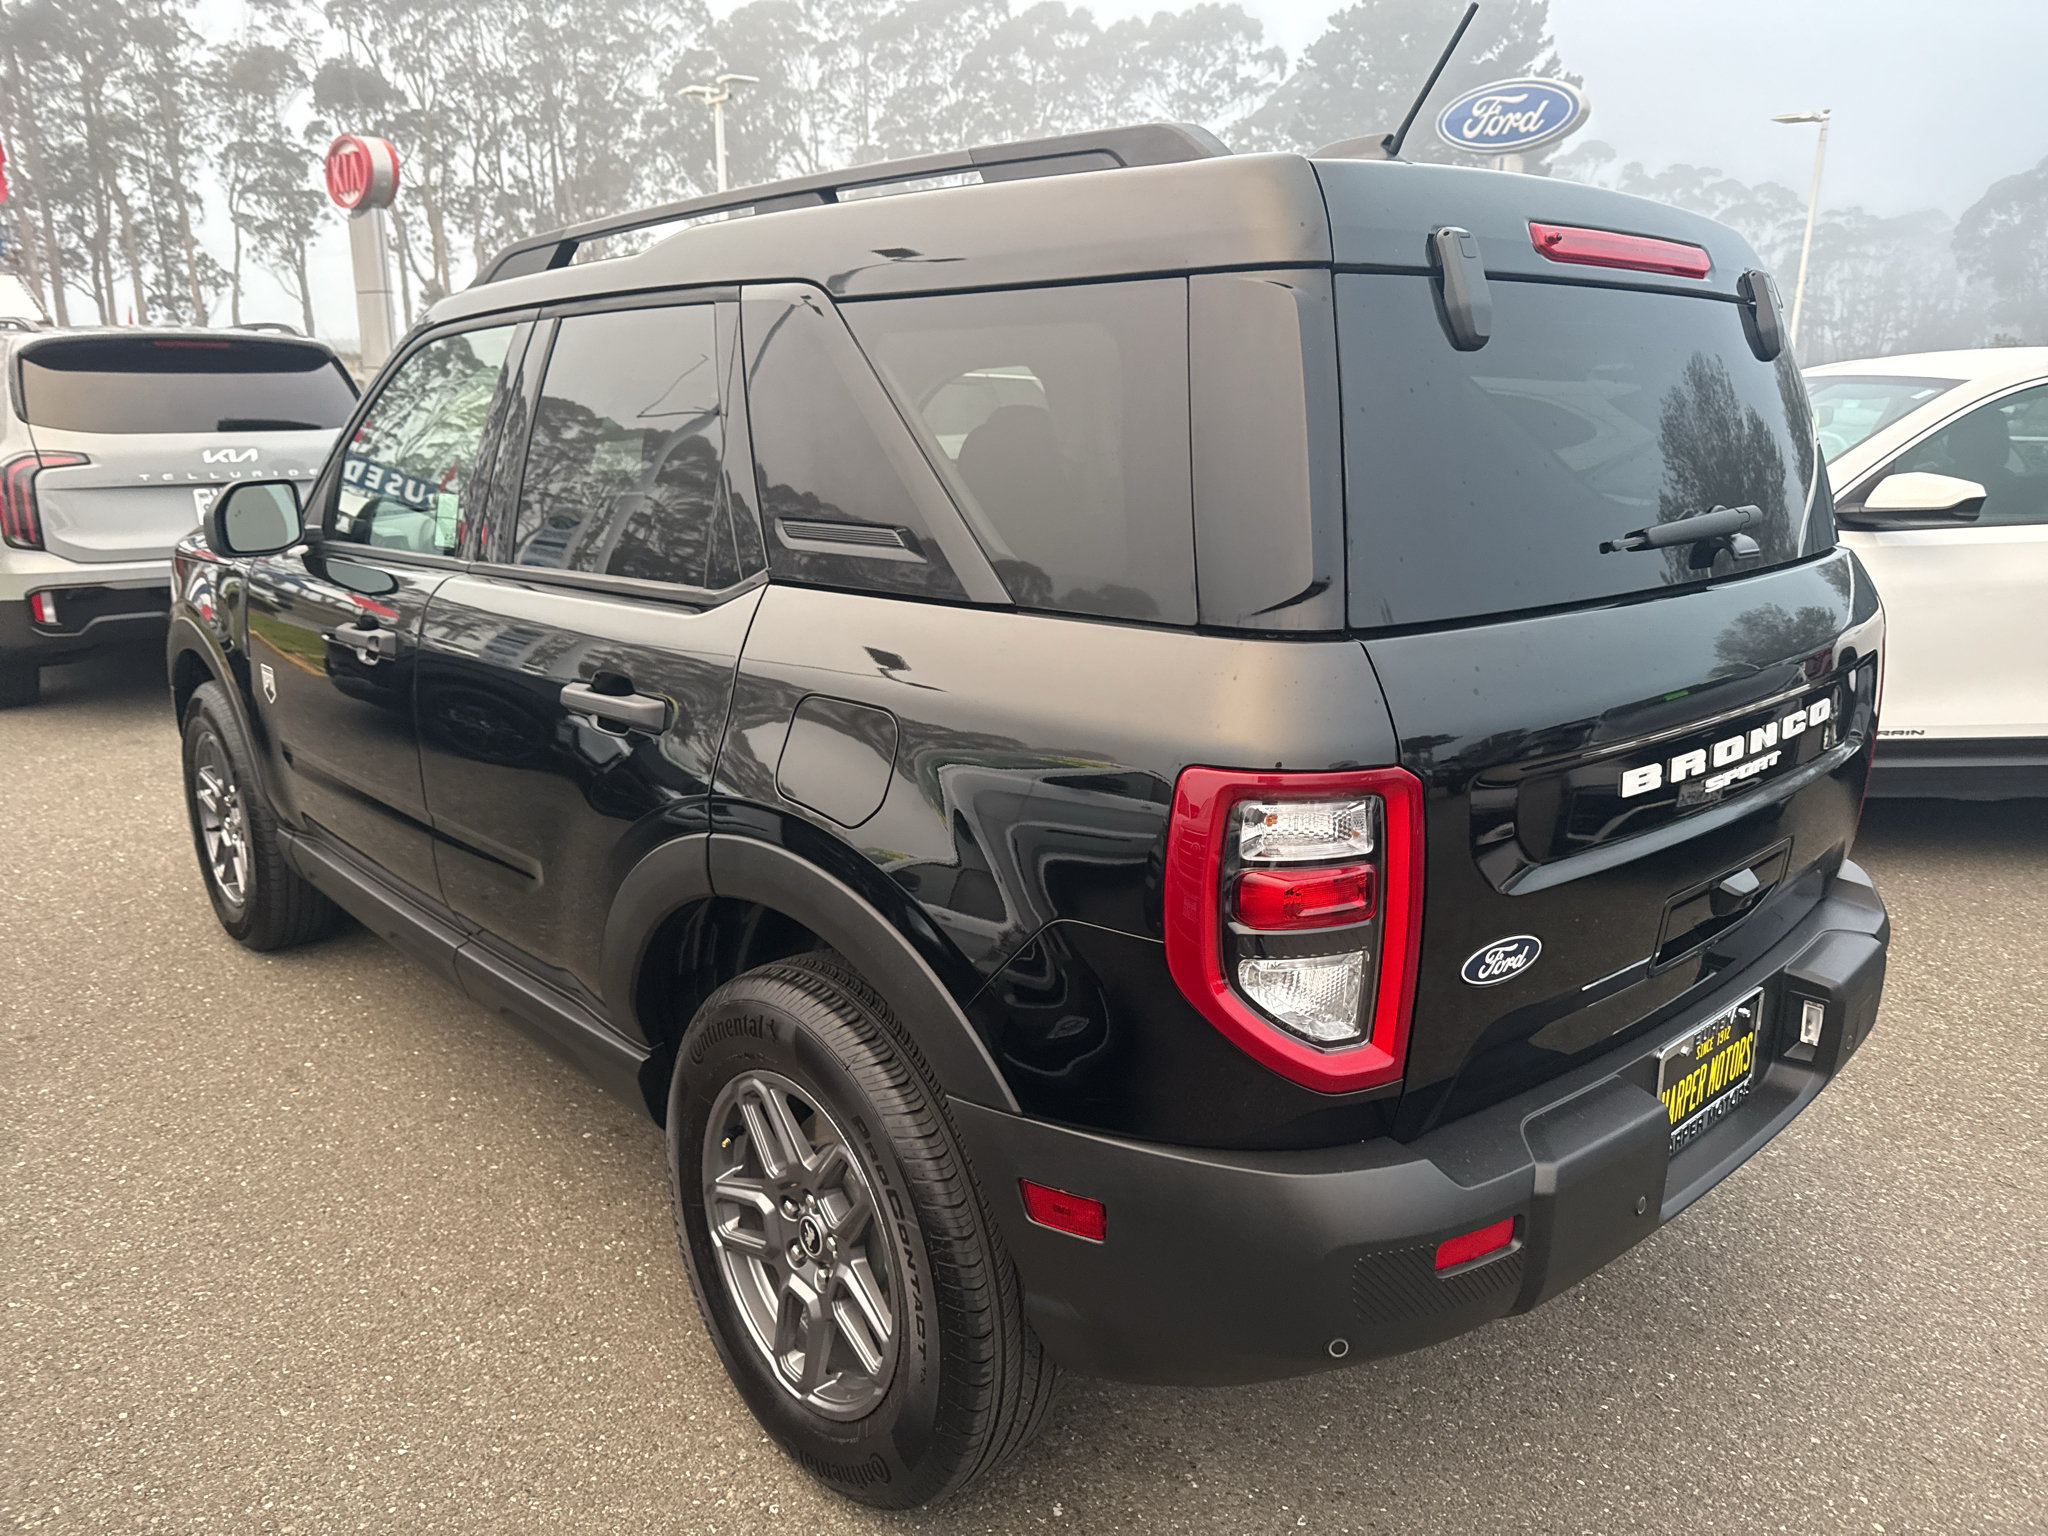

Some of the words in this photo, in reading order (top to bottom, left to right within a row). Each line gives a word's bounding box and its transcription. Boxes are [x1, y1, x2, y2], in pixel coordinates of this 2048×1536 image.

[1462, 93, 1549, 139] Ford
[138, 468, 319, 482] TELLURIDE
[202, 448, 259, 464] KIA
[1618, 697, 1831, 799] BRONCO
[1704, 750, 1782, 793] SPORT
[1477, 943, 1530, 979] Ford
[689, 1014, 764, 1065] Continental
[1695, 1036, 1714, 1060] SINCE
[1706, 1031, 1753, 1098] MOTORS
